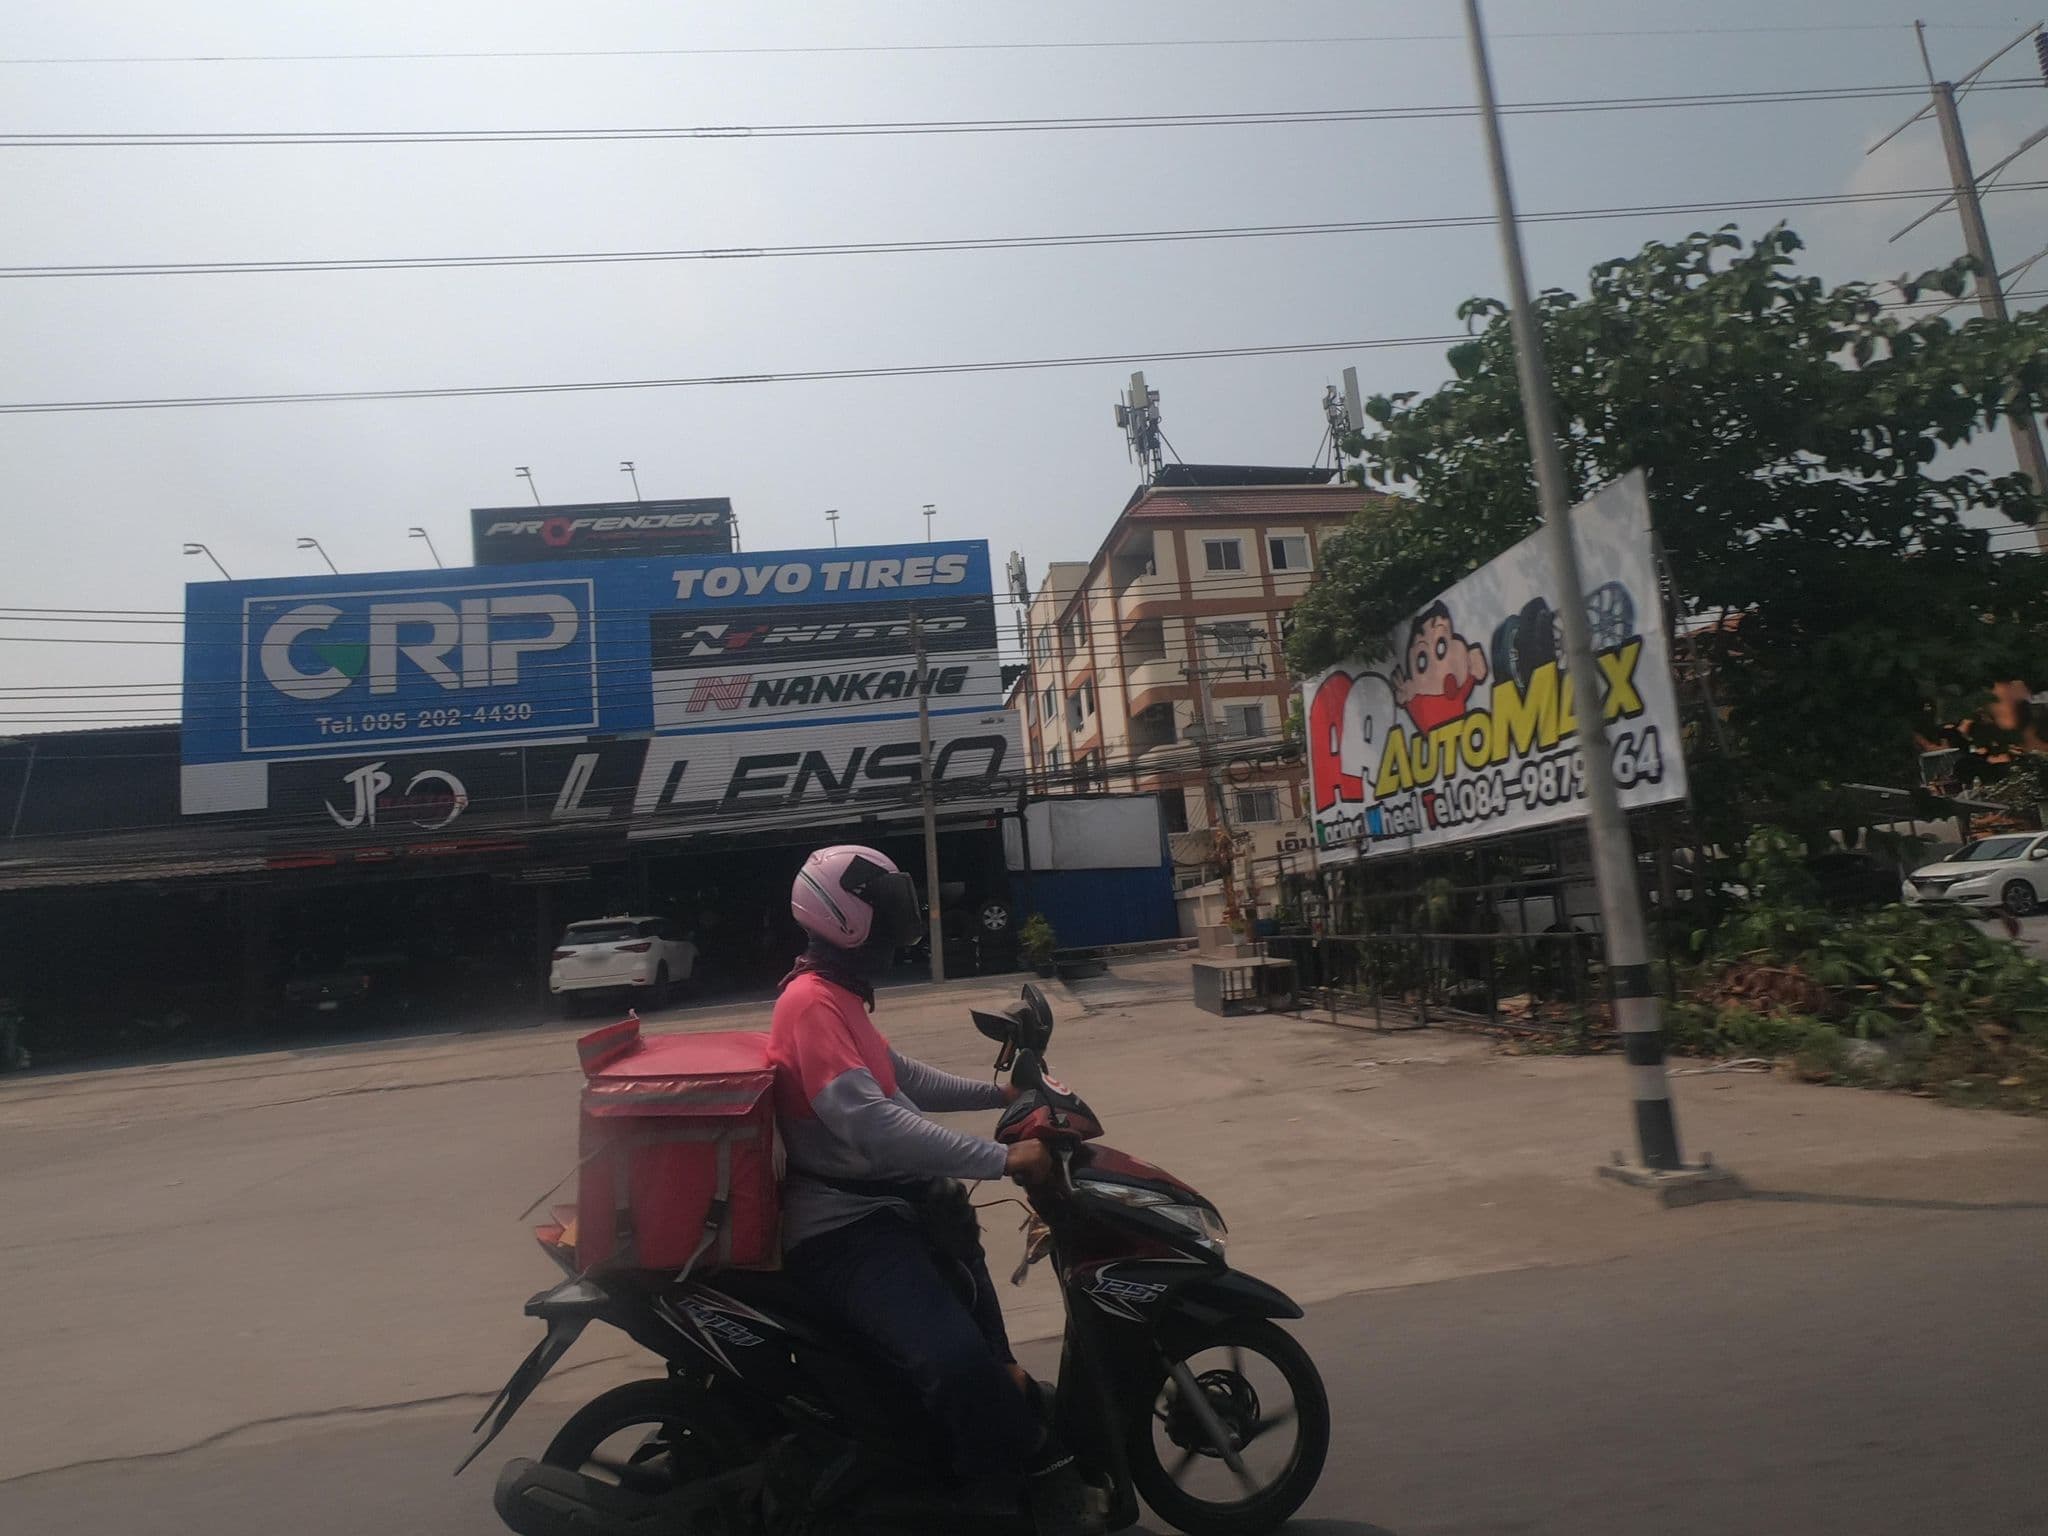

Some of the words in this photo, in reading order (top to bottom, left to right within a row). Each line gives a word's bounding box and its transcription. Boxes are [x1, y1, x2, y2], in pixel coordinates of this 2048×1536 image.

[484, 511, 721, 547] PROFENDER
[671, 562, 813, 600] TOYO
[819, 553, 970, 592] TIRES
[748, 664, 971, 709] NANKANG
[653, 733, 1009, 818] LENSO
[1421, 724, 1666, 831] Tel.084-987964
